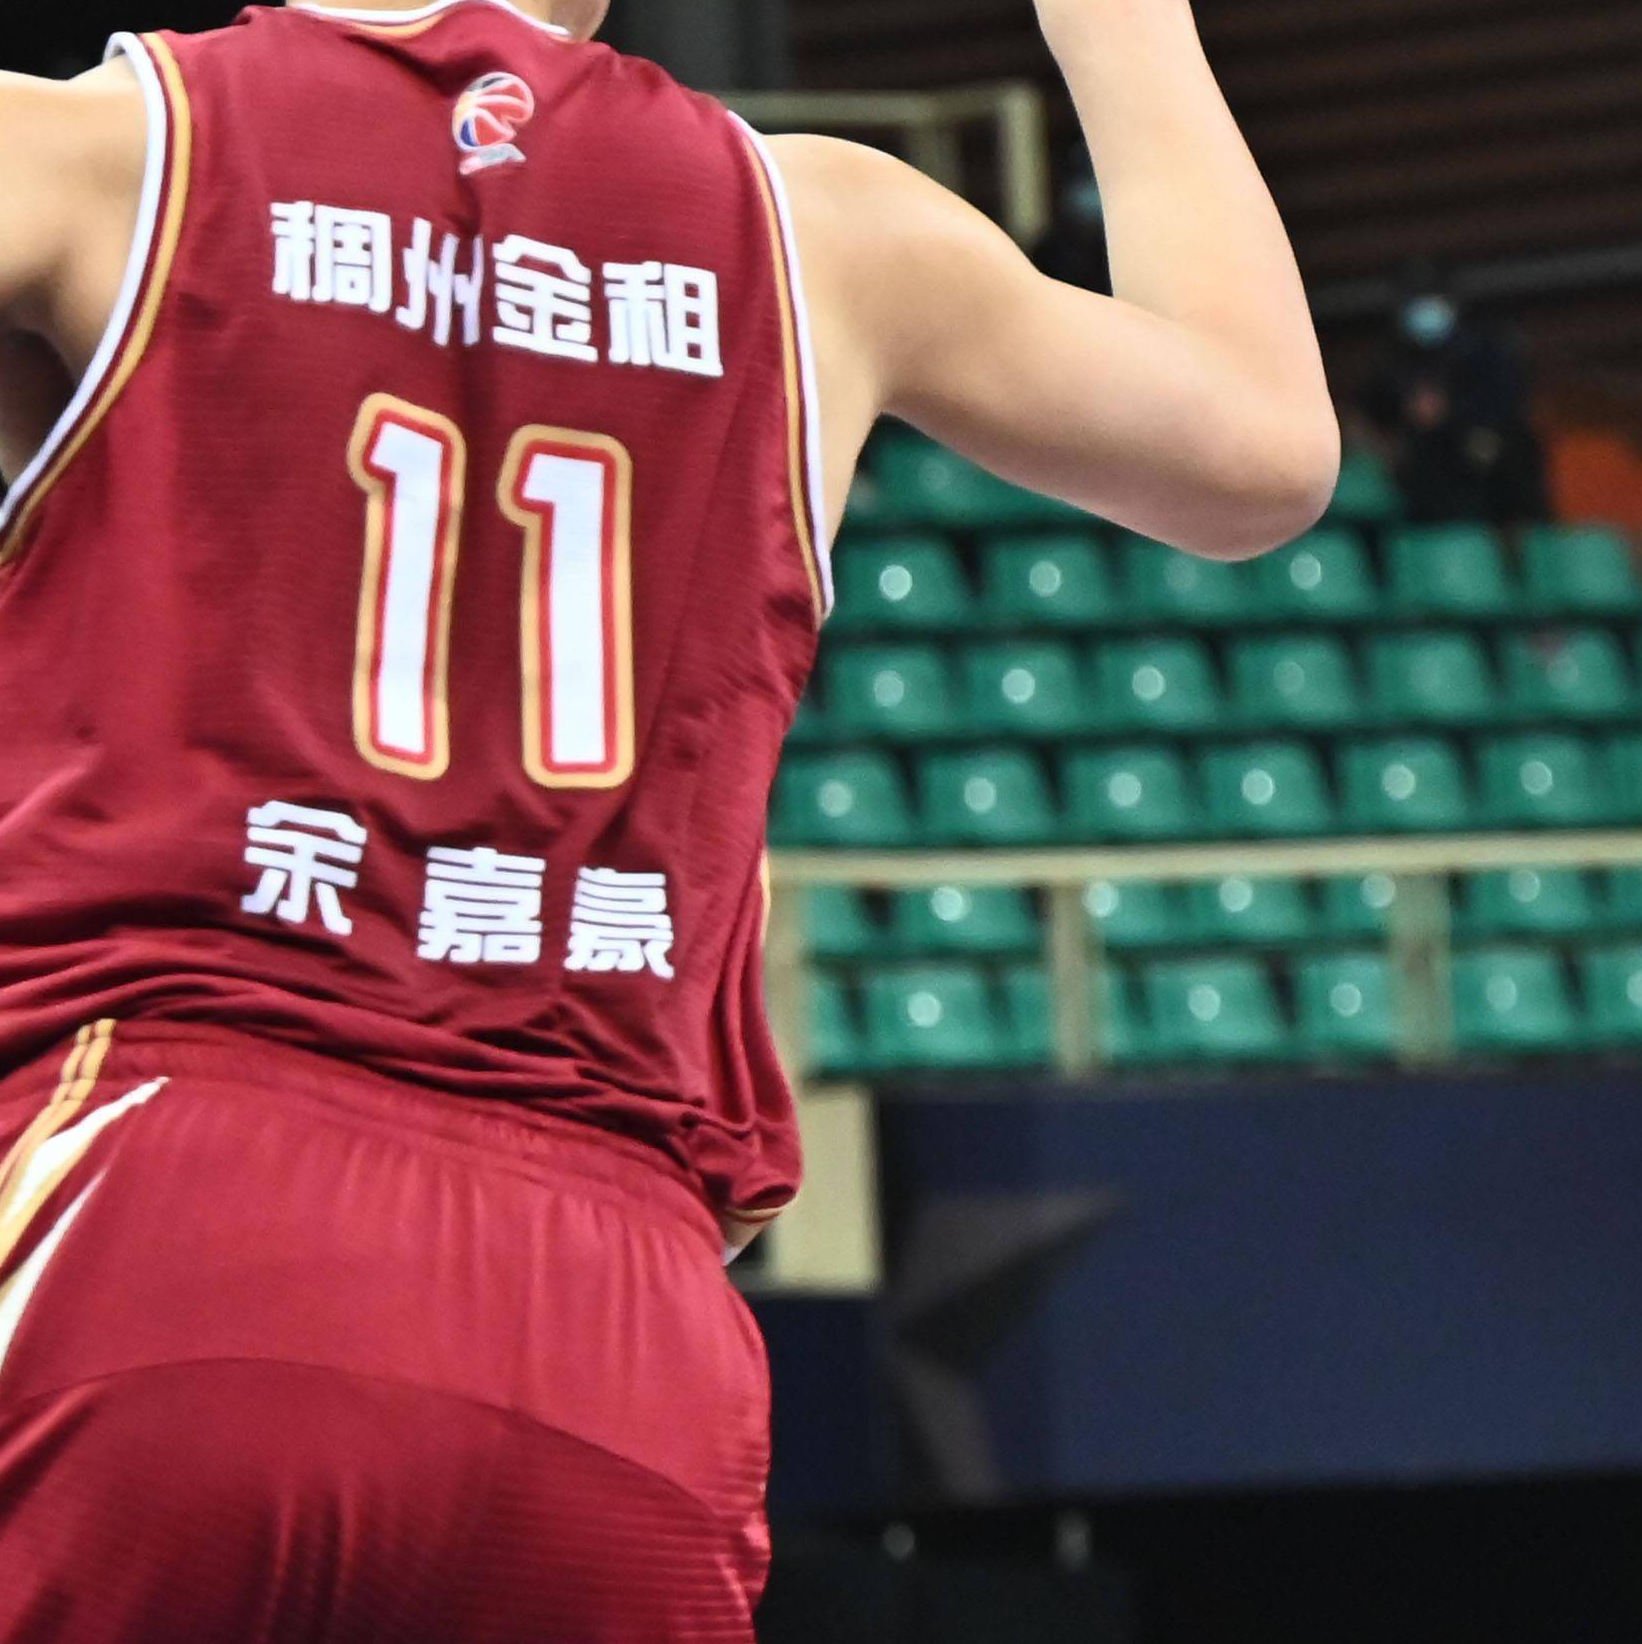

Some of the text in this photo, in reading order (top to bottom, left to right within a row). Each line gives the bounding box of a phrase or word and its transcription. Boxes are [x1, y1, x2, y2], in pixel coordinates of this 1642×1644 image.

[269, 200, 724, 378] 稠州金租
[347, 392, 633, 790] 11
